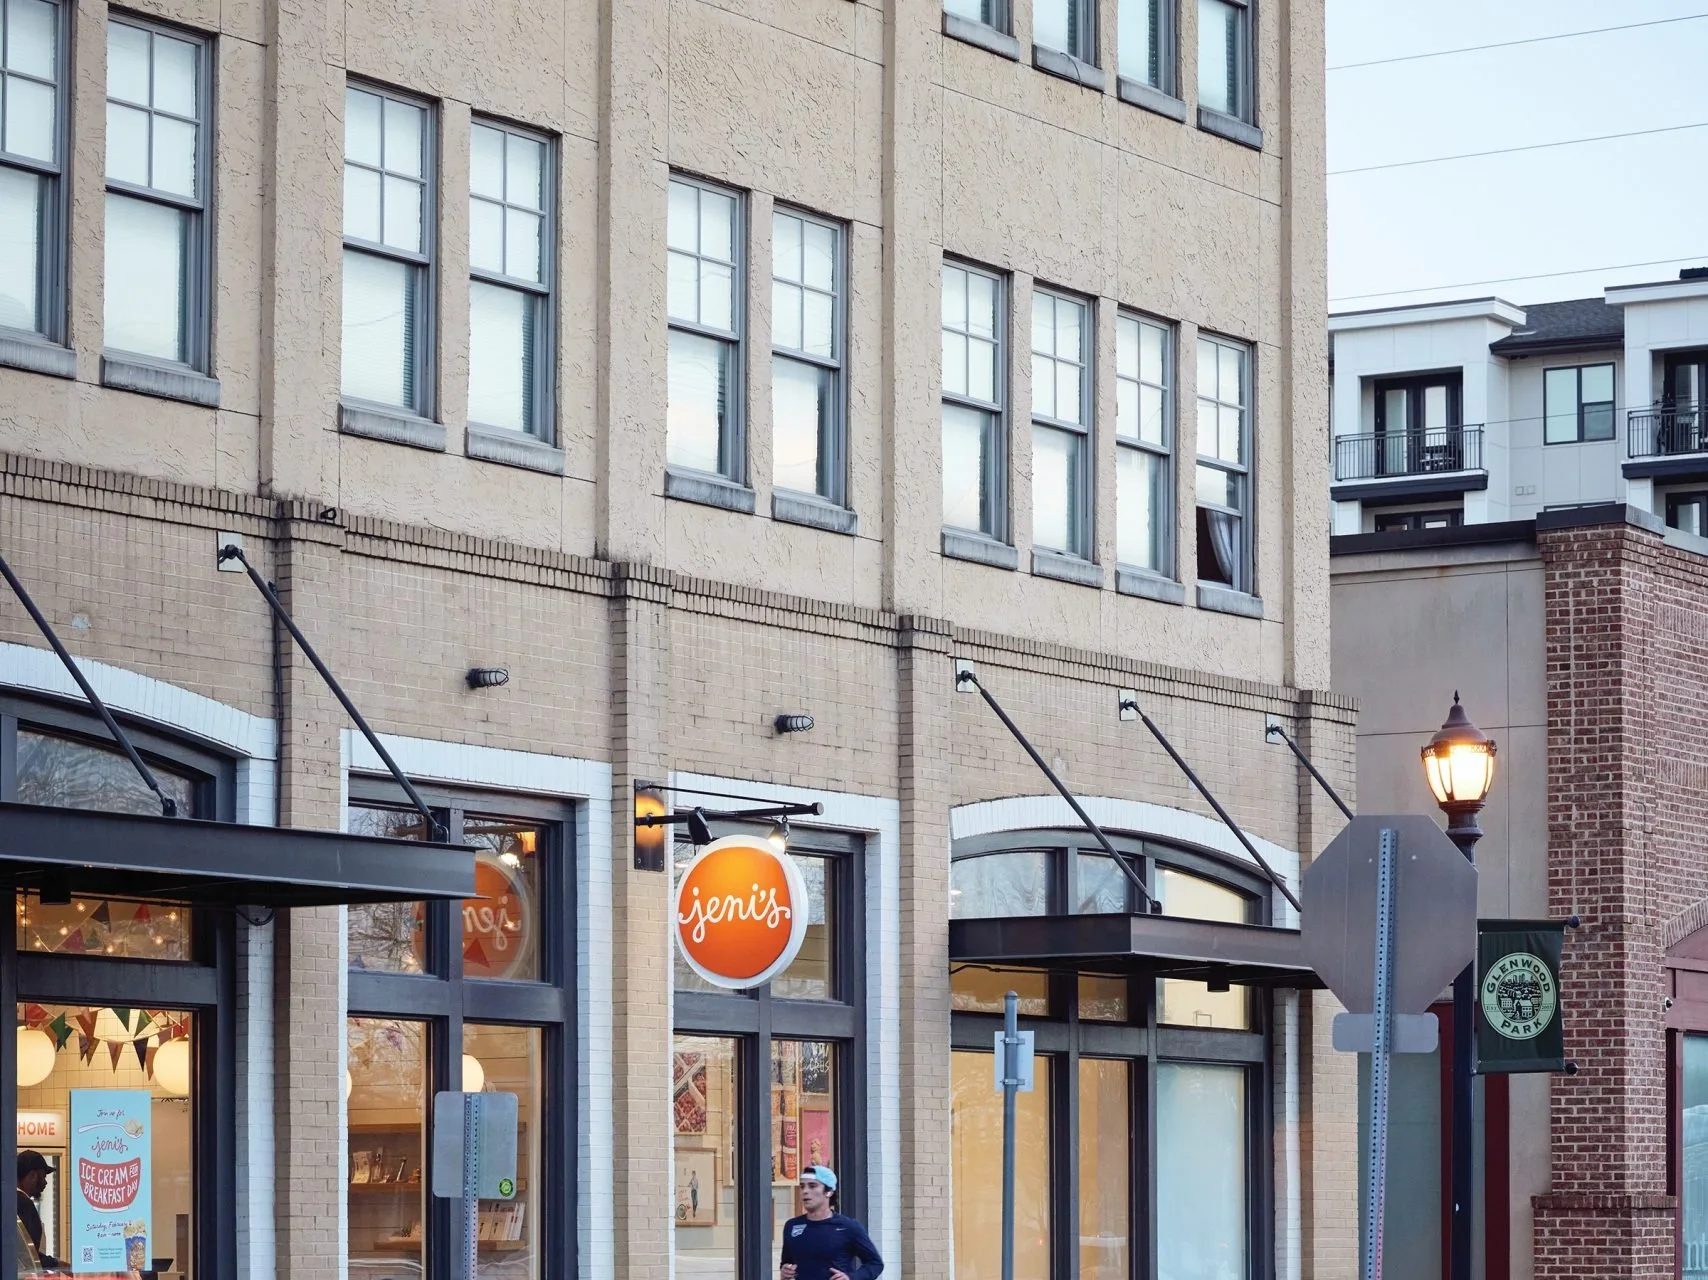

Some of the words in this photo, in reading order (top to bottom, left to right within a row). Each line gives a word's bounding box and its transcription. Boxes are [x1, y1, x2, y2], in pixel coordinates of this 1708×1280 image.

[679, 883, 791, 943] jeni's
[1486, 959, 1550, 993] GLENWOOD
[1500, 1018, 1542, 1035] PARK
[17, 1121, 55, 1136] HOME
[81, 1162, 96, 1183] ICE
[97, 1166, 128, 1186] CREAM
[129, 1163, 139, 1178] FOR
[84, 1182, 126, 1204] BREAKFAST
[127, 1180, 138, 1198] DAY
